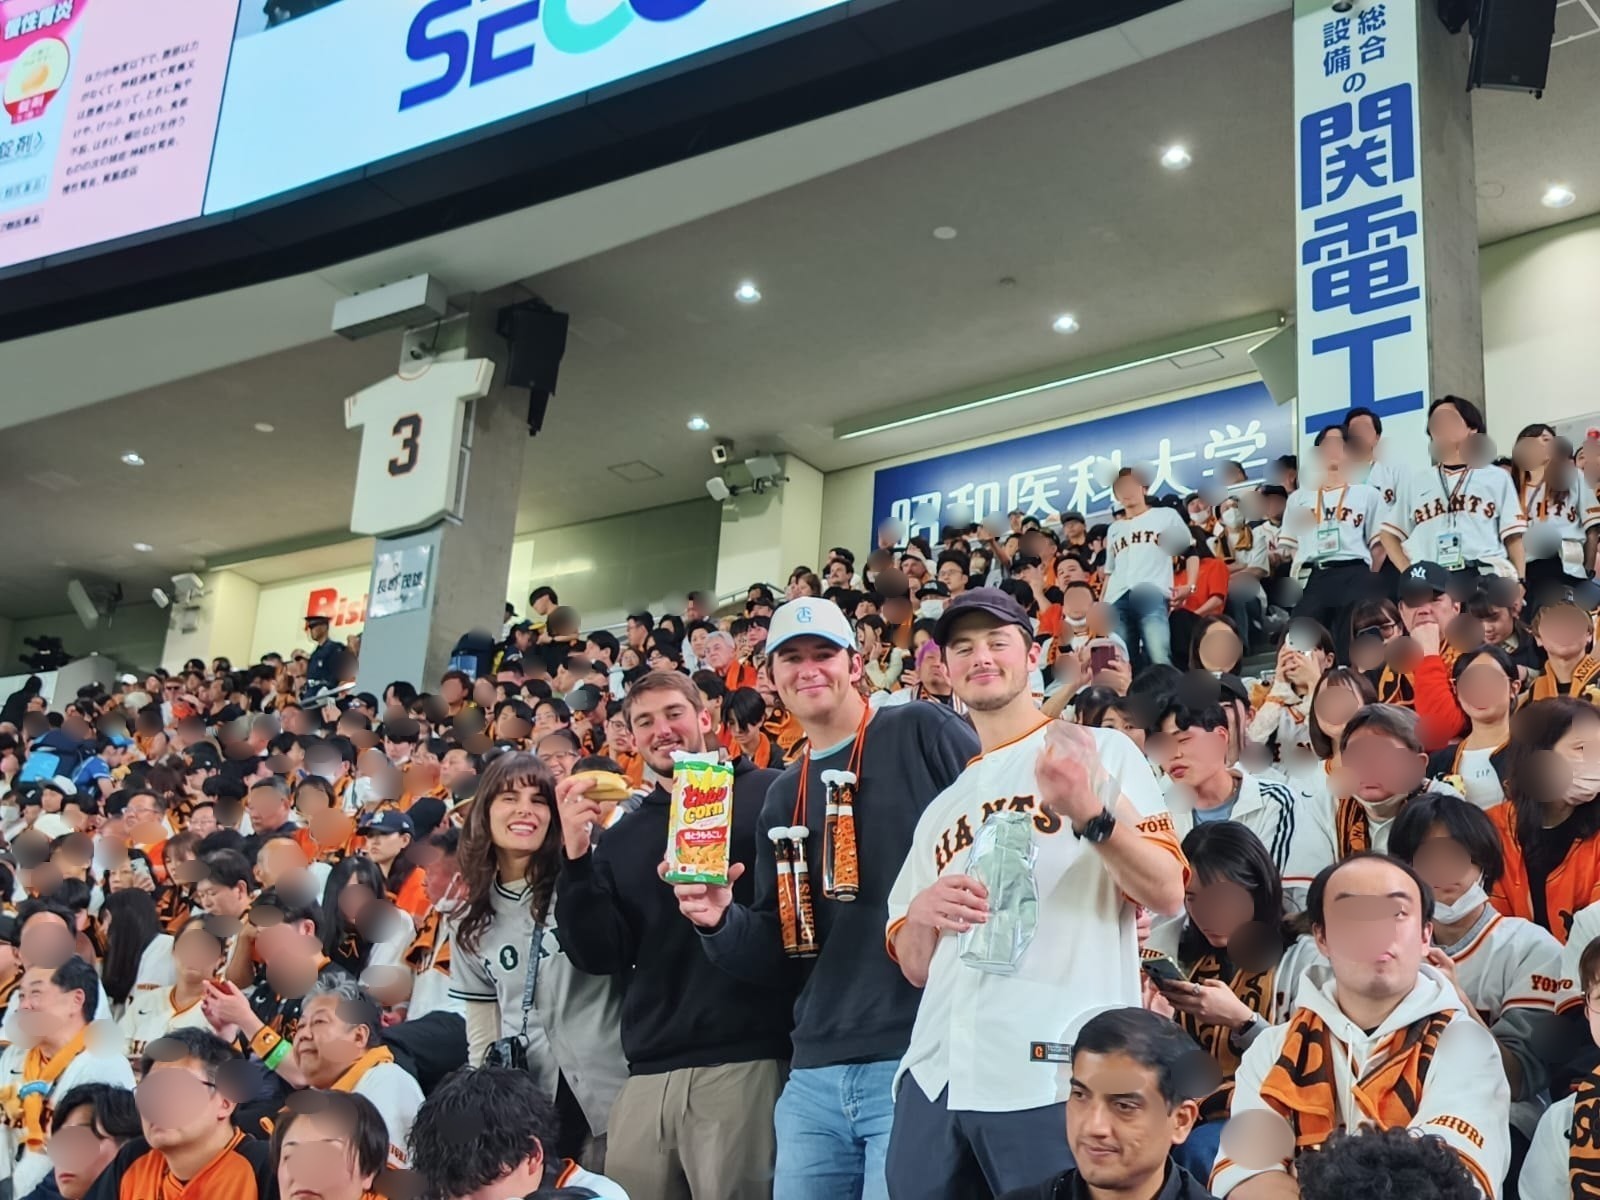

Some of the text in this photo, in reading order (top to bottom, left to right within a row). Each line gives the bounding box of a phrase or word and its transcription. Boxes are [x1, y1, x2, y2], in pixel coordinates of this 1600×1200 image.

[397, 0, 707, 113] SEC
[1323, 17, 1351, 77] 設備
[1358, 4, 1387, 65] 総合
[1342, 72, 1367, 93] の
[1300, 82, 1424, 434] 関電工
[387, 412, 423, 478] 3
[889, 419, 1269, 549] 昭和医科大学
[1414, 494, 1497, 525] GIANTS
[304, 587, 368, 632] Bis
